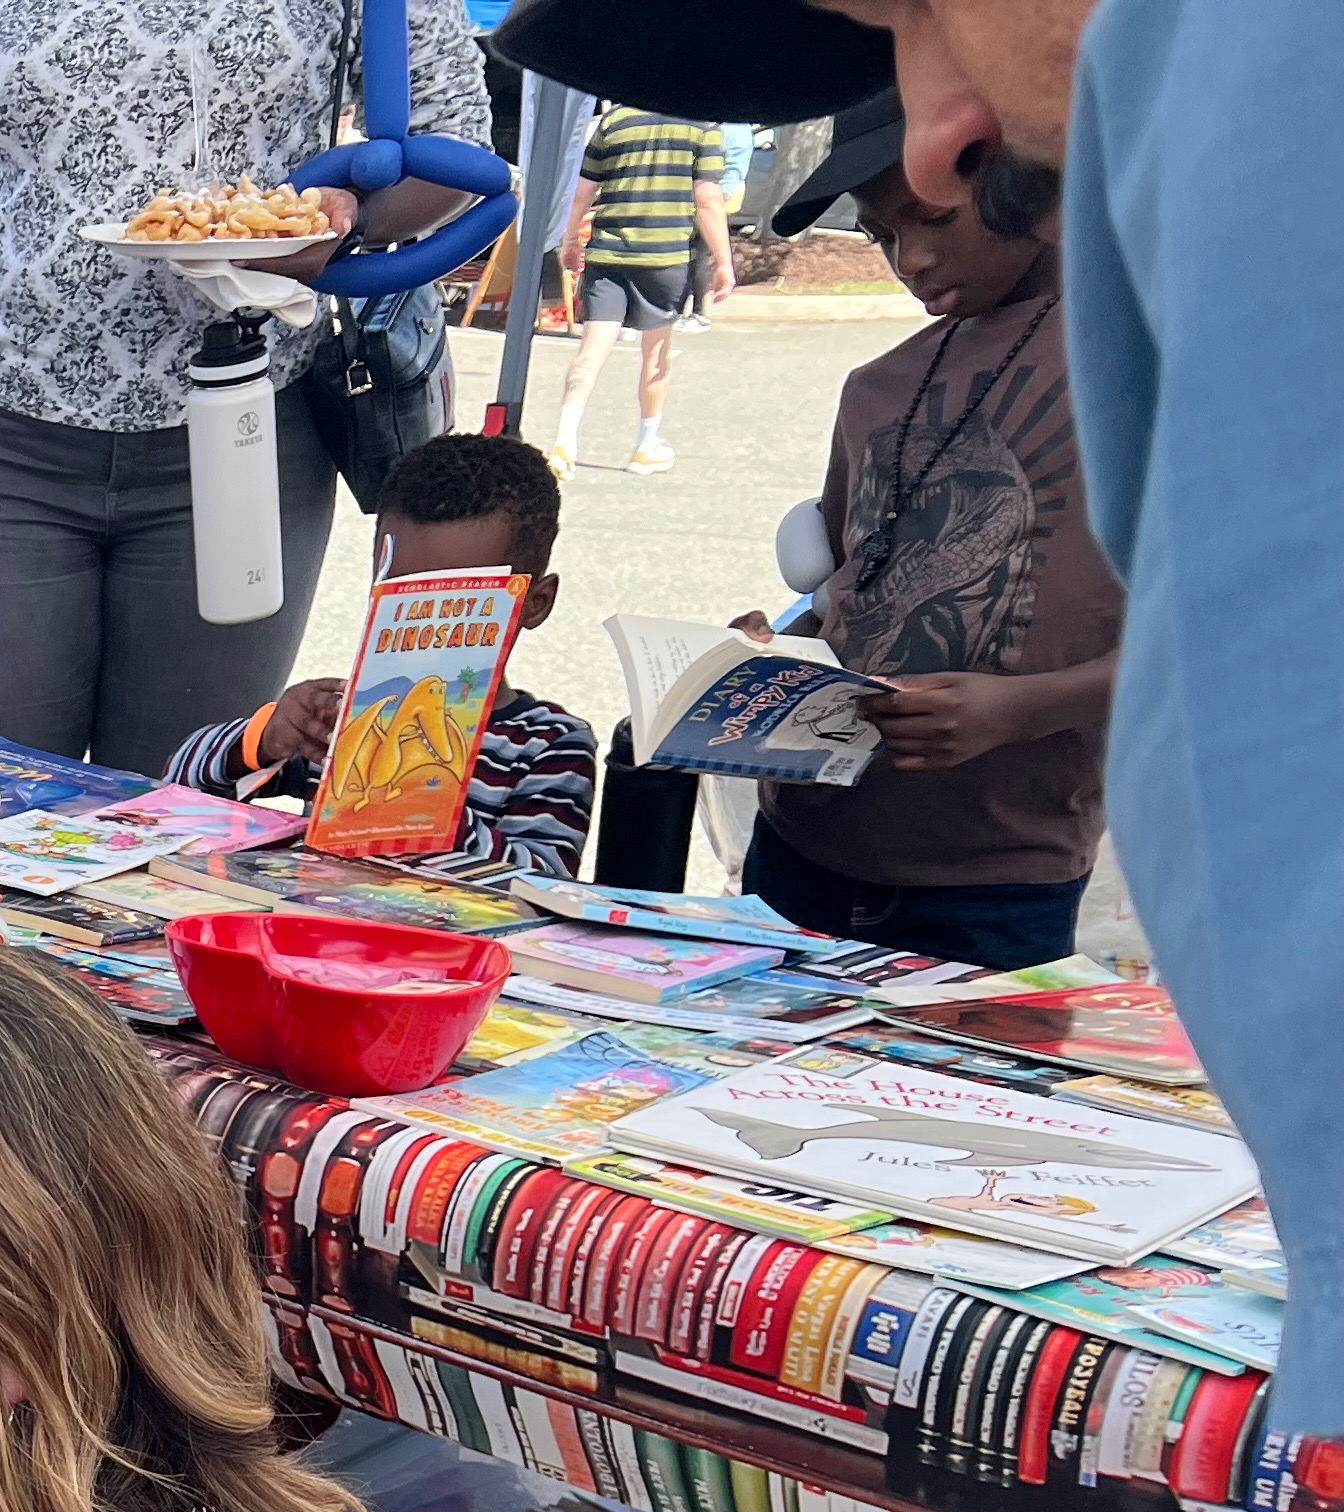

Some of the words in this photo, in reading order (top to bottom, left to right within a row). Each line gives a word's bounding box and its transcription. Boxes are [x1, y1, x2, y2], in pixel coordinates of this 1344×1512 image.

[398, 581, 458, 593] SCHOLASTIC
[394, 602, 403, 622] I
[405, 599, 436, 620] AM
[439, 597, 477, 619] NOT
[480, 597, 495, 616] A
[374, 622, 501, 654] DINOSAUR
[689, 664, 758, 722] DIARY
[707, 685, 787, 746] Wimpy
[767, 664, 825, 687] Kid
[762, 1073, 857, 1091] The
[867, 1079, 1011, 1106] House
[727, 1086, 866, 1105] Across
[881, 1095, 961, 1111] the
[975, 1104, 1120, 1137] Street
[856, 1151, 952, 1173] Jules
[1030, 1170, 1157, 1189] Feiffer
